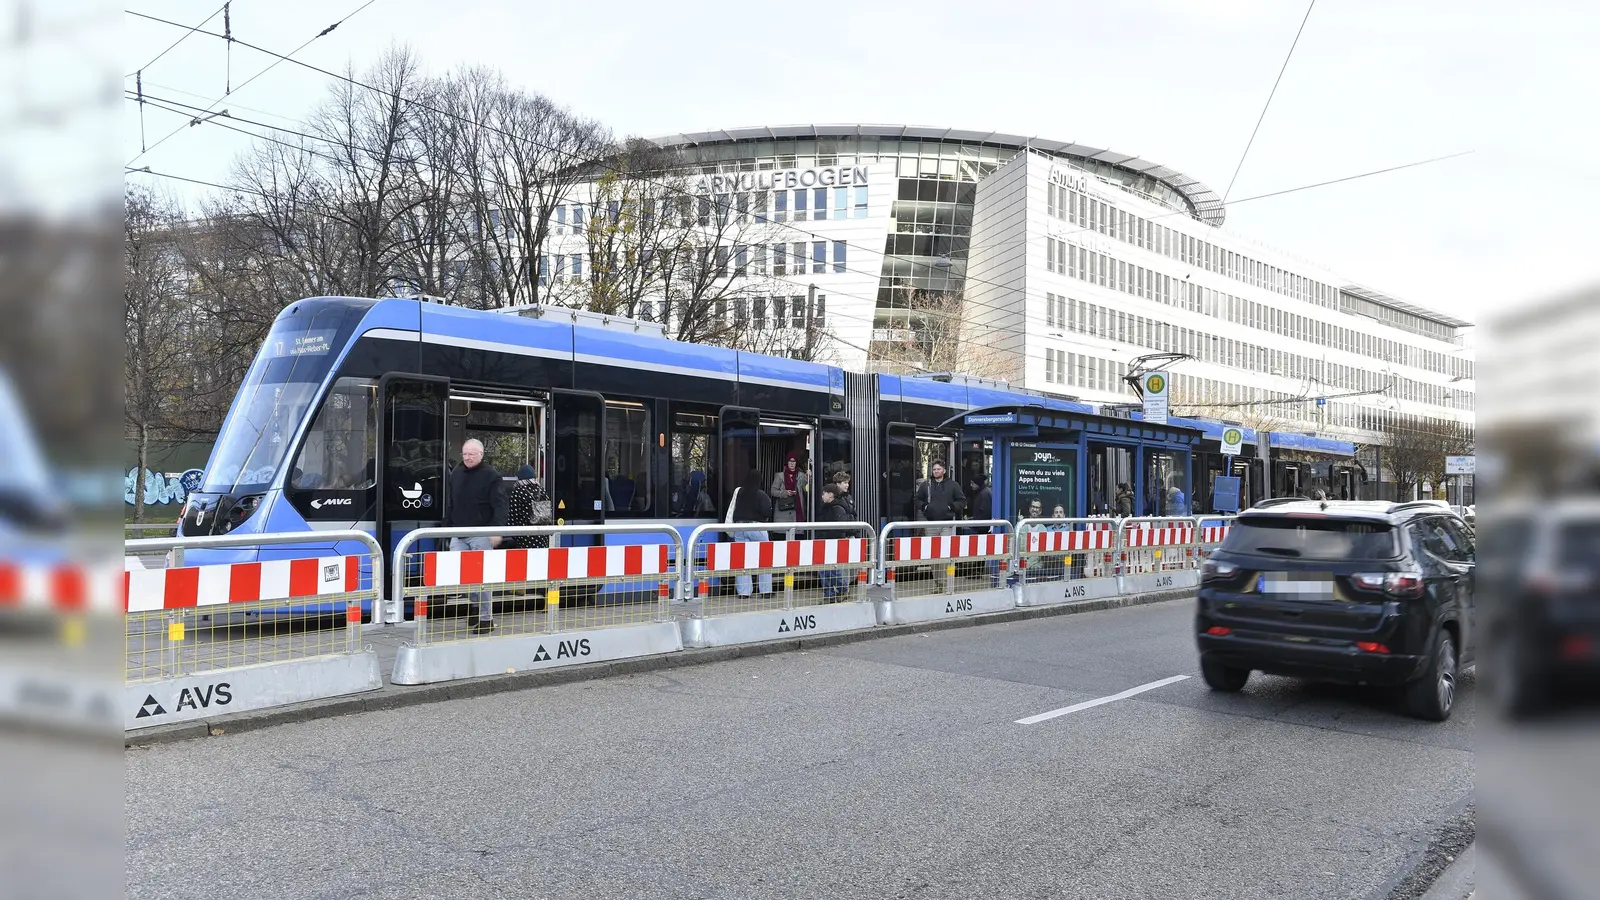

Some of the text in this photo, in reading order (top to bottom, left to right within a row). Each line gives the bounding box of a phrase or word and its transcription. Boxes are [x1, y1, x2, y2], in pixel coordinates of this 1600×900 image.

[696, 166, 869, 193] ARNULFBOGEN
[275, 341, 284, 355] 17
[1018, 468, 1035, 476] Wenn
[1052, 469, 1066, 477] viele
[1018, 476, 1034, 484] Apps
[322, 498, 352, 506] MVG
[1162, 576, 1173, 587] AVS
[1072, 585, 1086, 597] AVS
[956, 598, 973, 611] AVS
[793, 614, 817, 631] AVS
[556, 638, 591, 659] AVS
[176, 682, 232, 712] AVS
